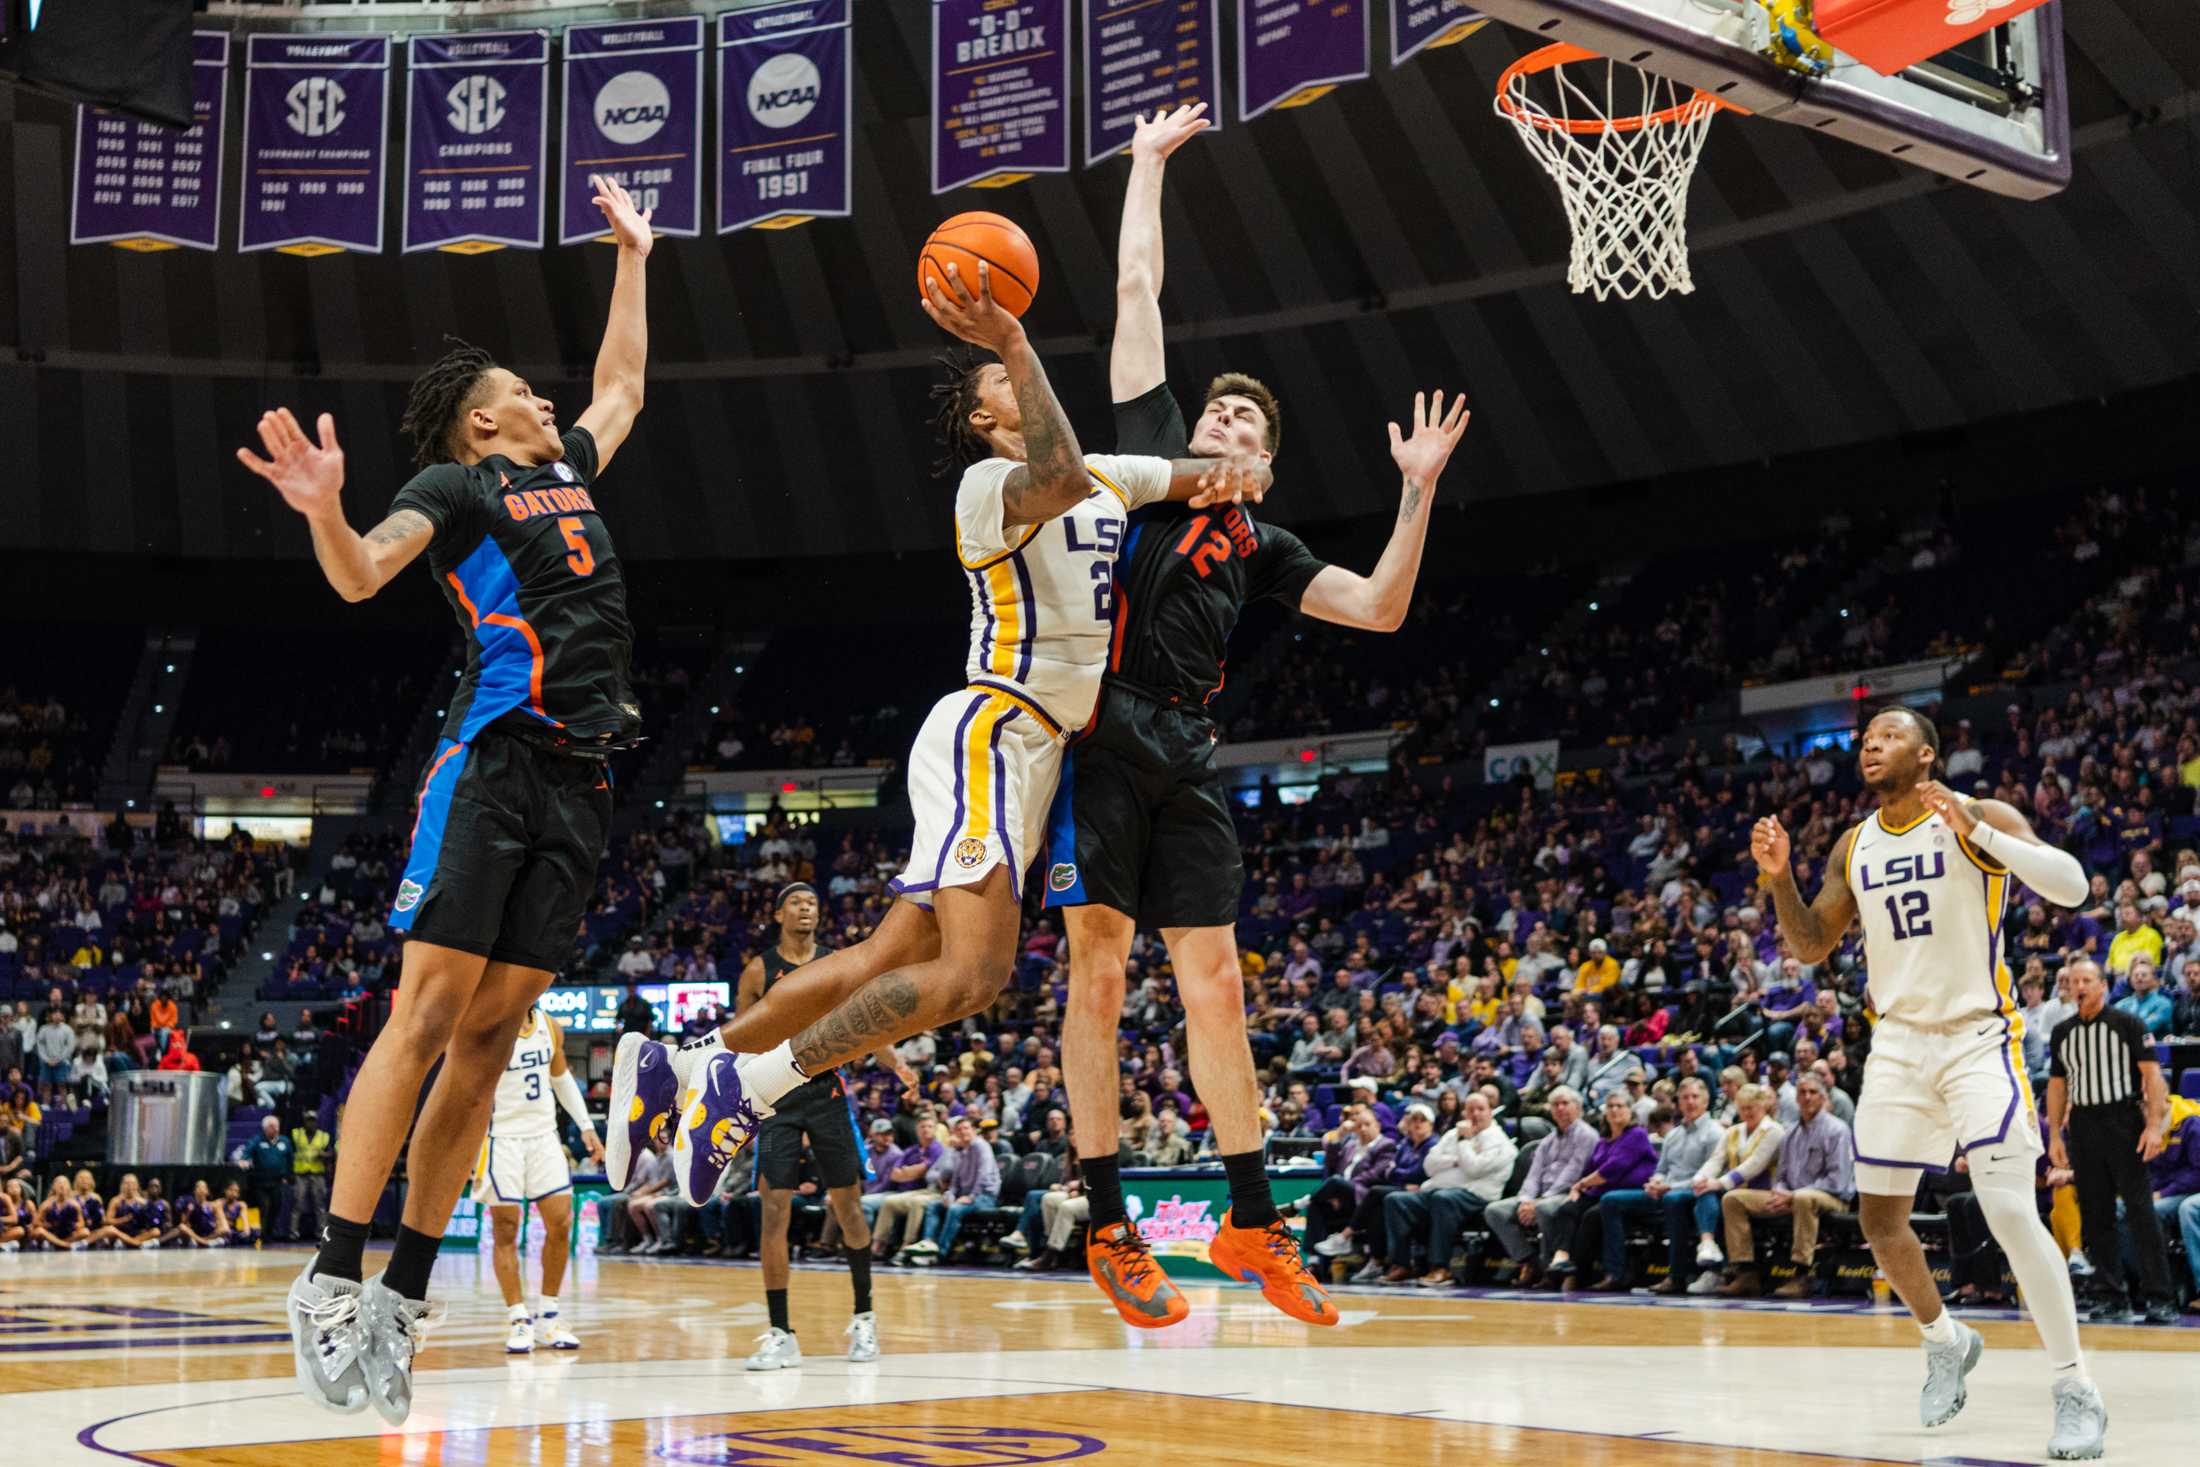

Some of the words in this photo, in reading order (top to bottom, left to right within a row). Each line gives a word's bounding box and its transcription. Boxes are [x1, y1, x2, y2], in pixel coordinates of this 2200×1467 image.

[286, 45, 350, 57] VOLLEYBALL
[957, 26, 1045, 63] BREAUX
[285, 76, 347, 137] SEC
[446, 75, 507, 134] SEC
[756, 86, 817, 111] NCAA
[603, 105, 667, 126] NCAA
[258, 149, 316, 160] TOURNAMENT
[317, 149, 370, 160] CHAMPIONS
[439, 142, 512, 157] CHAMPIONS
[742, 157, 782, 175] FINAL
[785, 150, 823, 169] FOUR
[588, 171, 630, 188] FAL
[633, 168, 672, 185] FOUR
[757, 171, 808, 200] 1991
[503, 487, 595, 522] GATORS
[557, 516, 596, 577] 5
[1063, 515, 1125, 554] LS
[1175, 514, 1232, 579] 12
[1861, 851, 1945, 891] LSU
[1885, 890, 1933, 941] 12
[524, 1074, 541, 1101] 3
